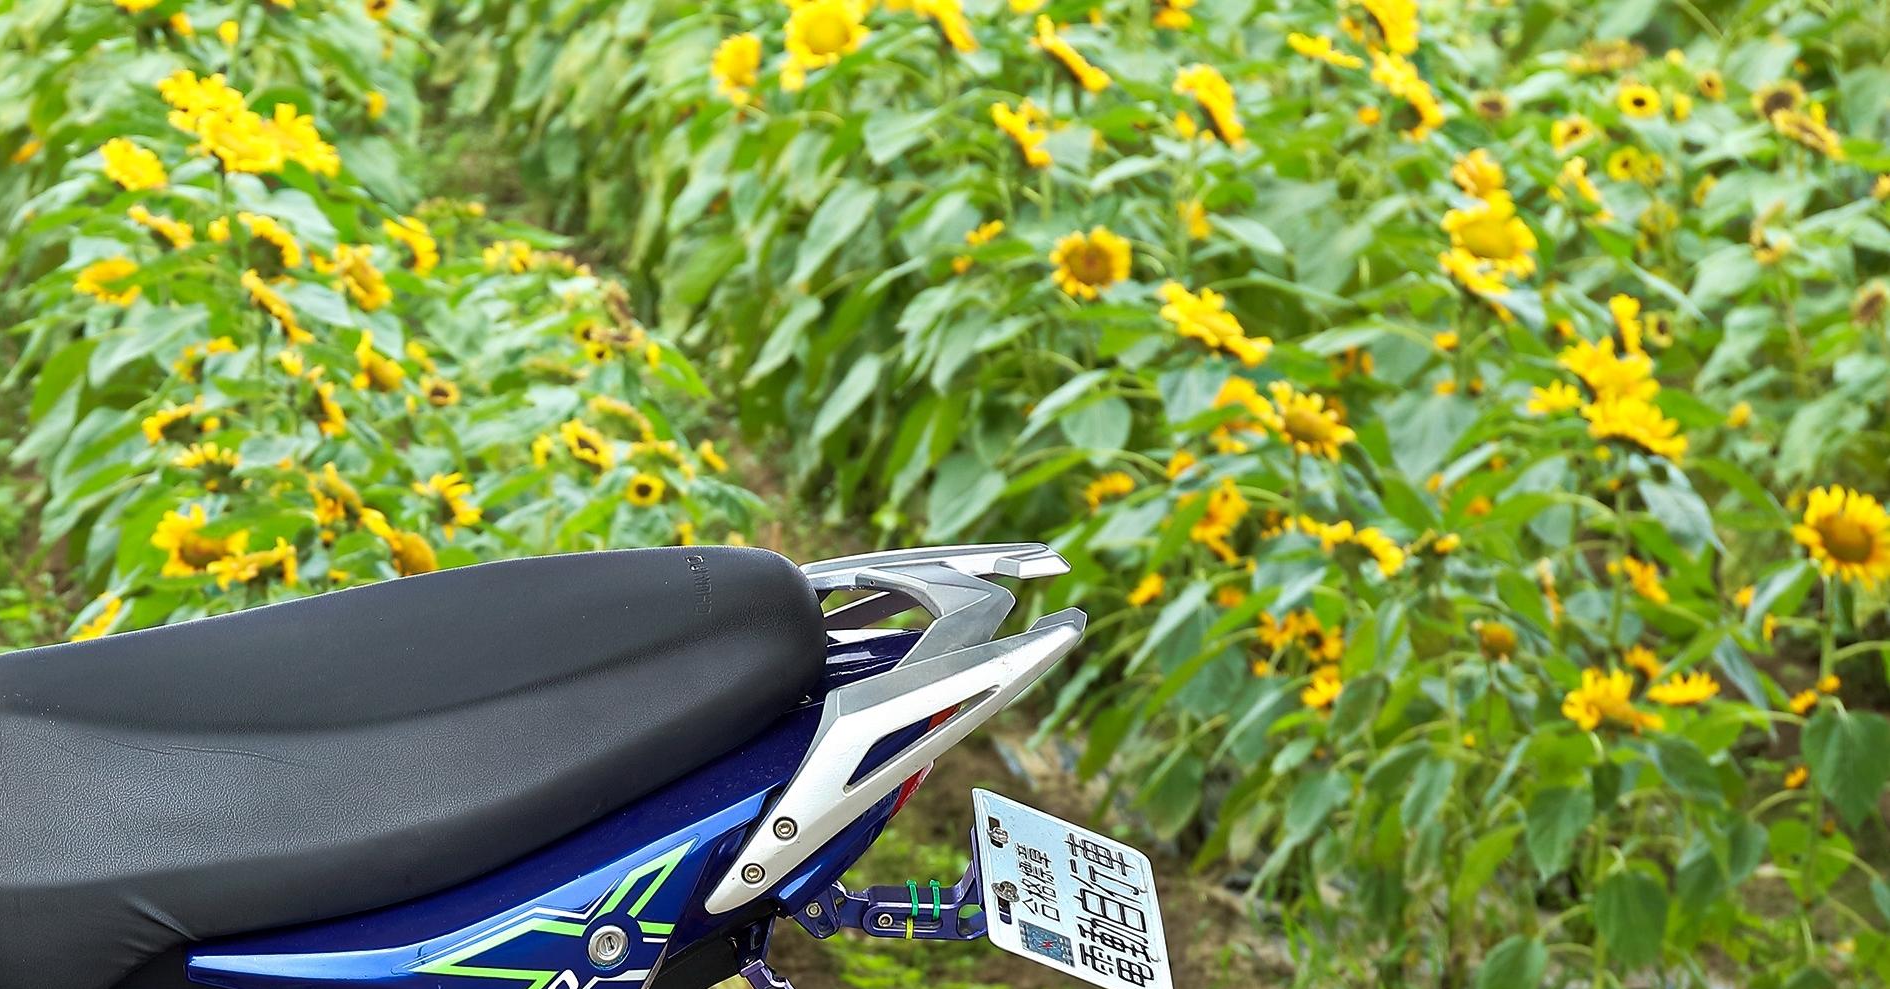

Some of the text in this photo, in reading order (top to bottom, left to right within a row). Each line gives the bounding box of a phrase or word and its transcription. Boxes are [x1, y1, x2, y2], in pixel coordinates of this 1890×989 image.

[1014, 842, 1060, 922] 合格標章
[1065, 832, 1155, 988] 電動自行車
